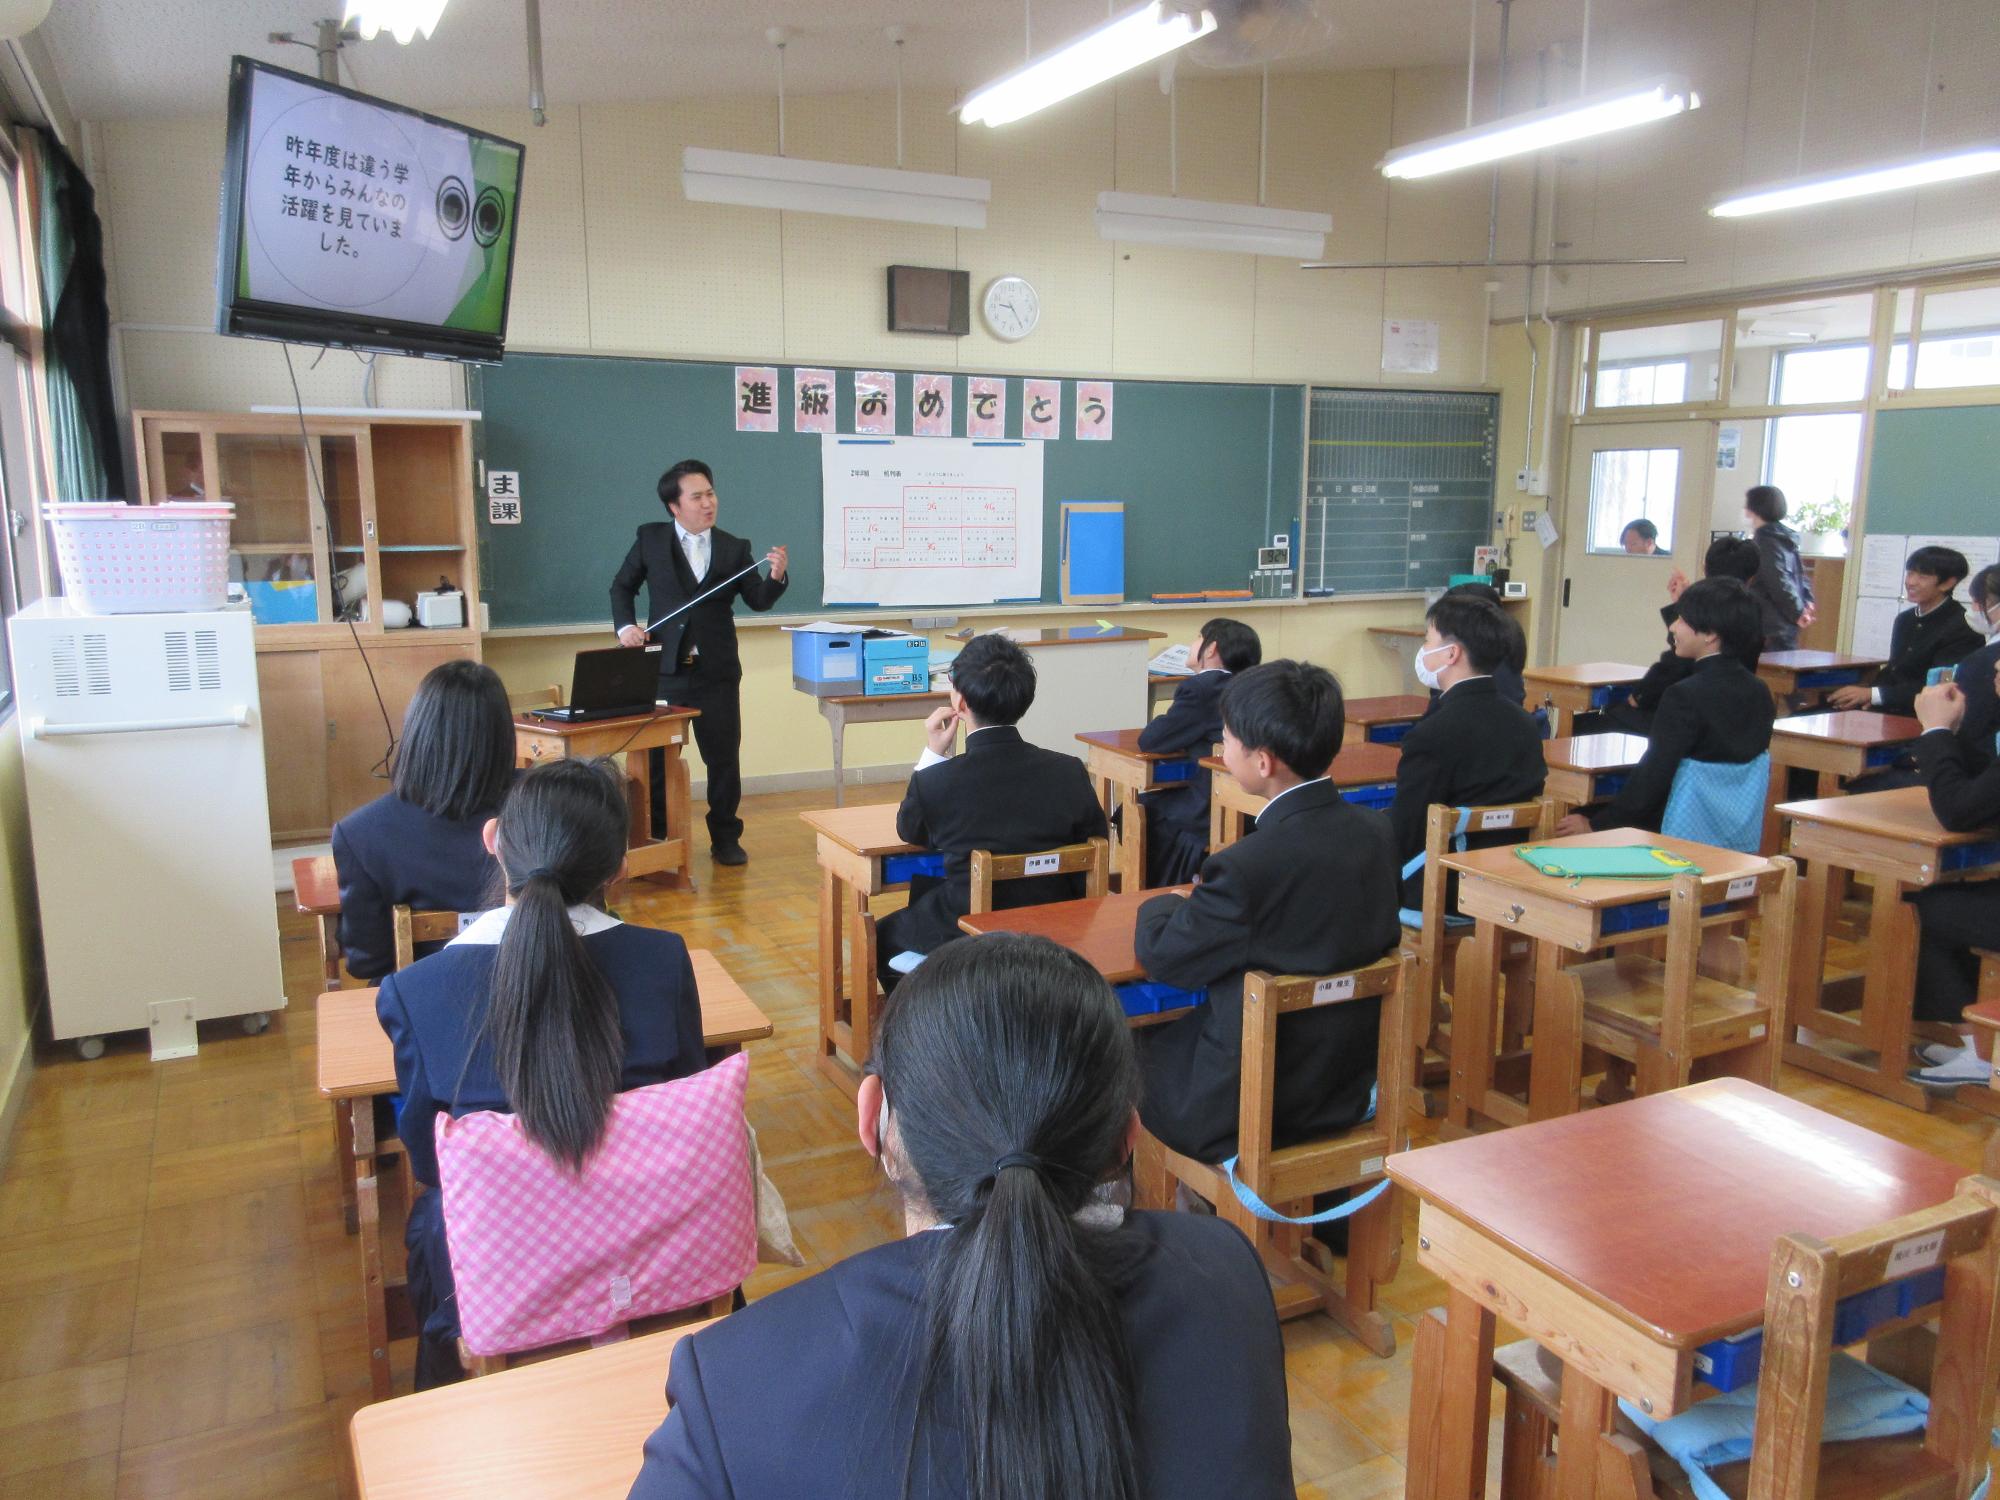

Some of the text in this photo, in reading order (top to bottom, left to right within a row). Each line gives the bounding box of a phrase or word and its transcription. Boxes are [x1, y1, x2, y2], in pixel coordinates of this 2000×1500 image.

[286, 135, 409, 184] 昨年度は違う学
[284, 165, 406, 211] 年からみんなの
[281, 194, 403, 238] 活躍を見ていま
[319, 232, 360, 258] した。
[493, 475, 514, 494] ま
[491, 502, 519, 520] 課
[912, 673, 923, 681] B5
